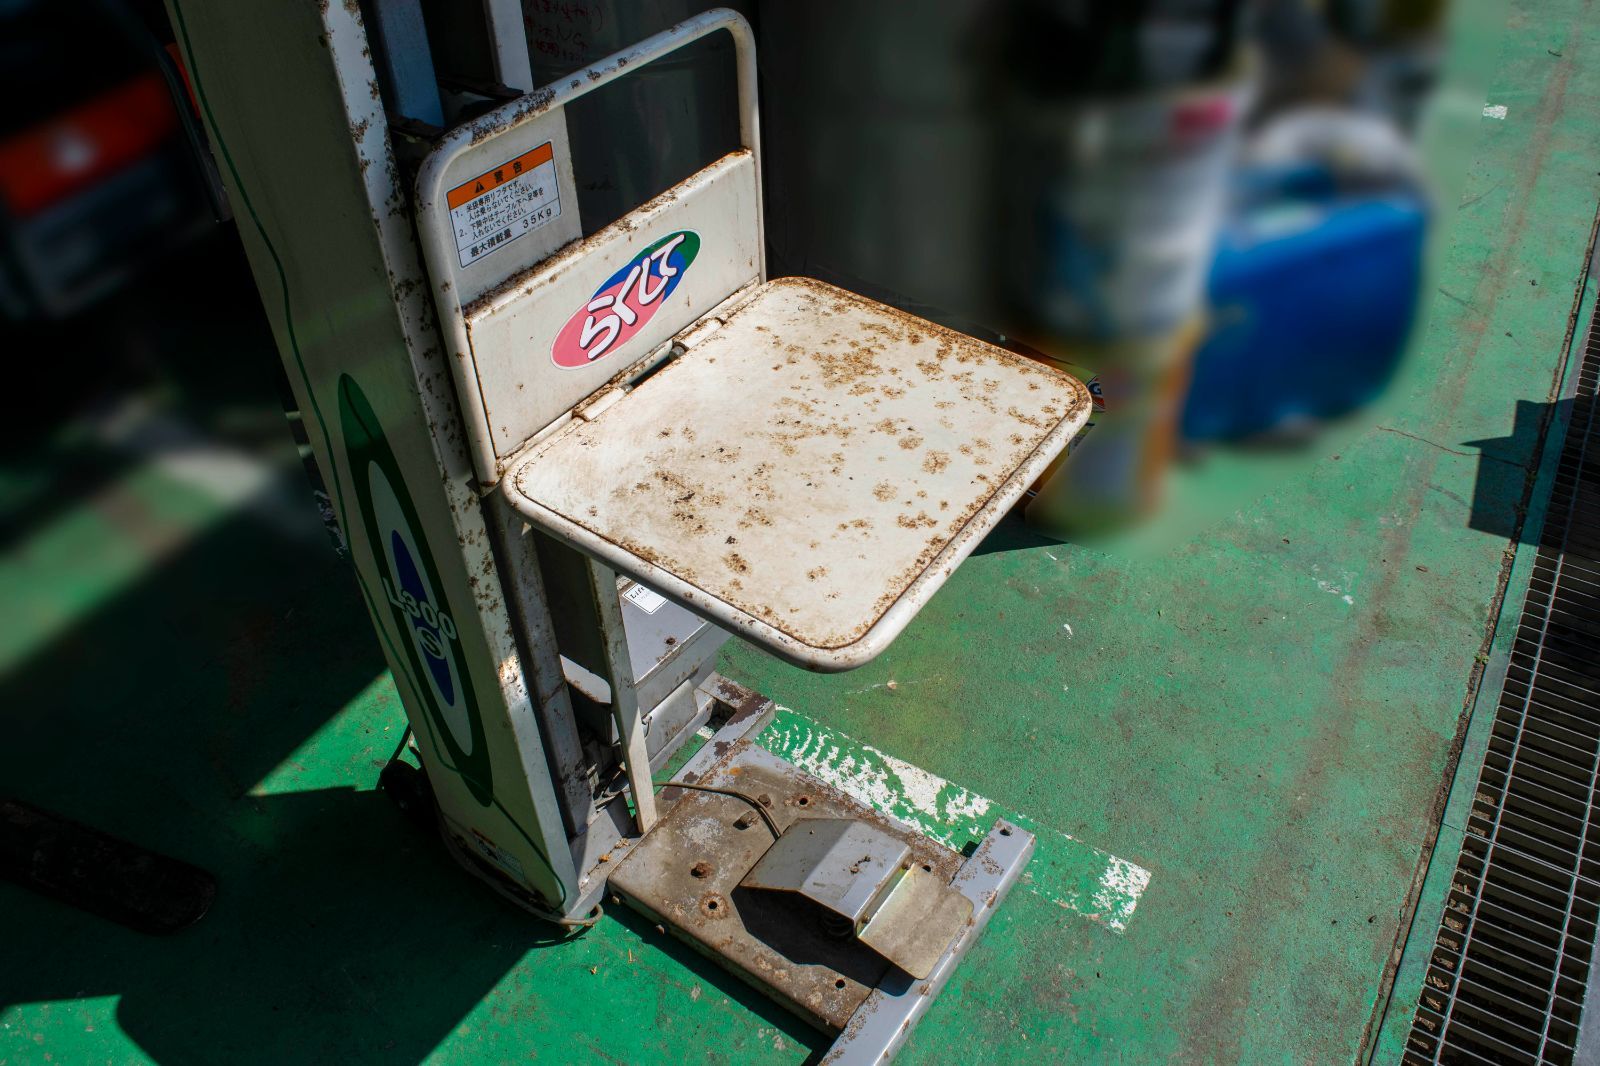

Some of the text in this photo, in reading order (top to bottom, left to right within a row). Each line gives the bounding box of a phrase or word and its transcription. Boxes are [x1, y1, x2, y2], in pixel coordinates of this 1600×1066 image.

[493, 161, 523, 184] 警告
[470, 228, 512, 258] 最大積載量
[382, 577, 457, 640] L300
